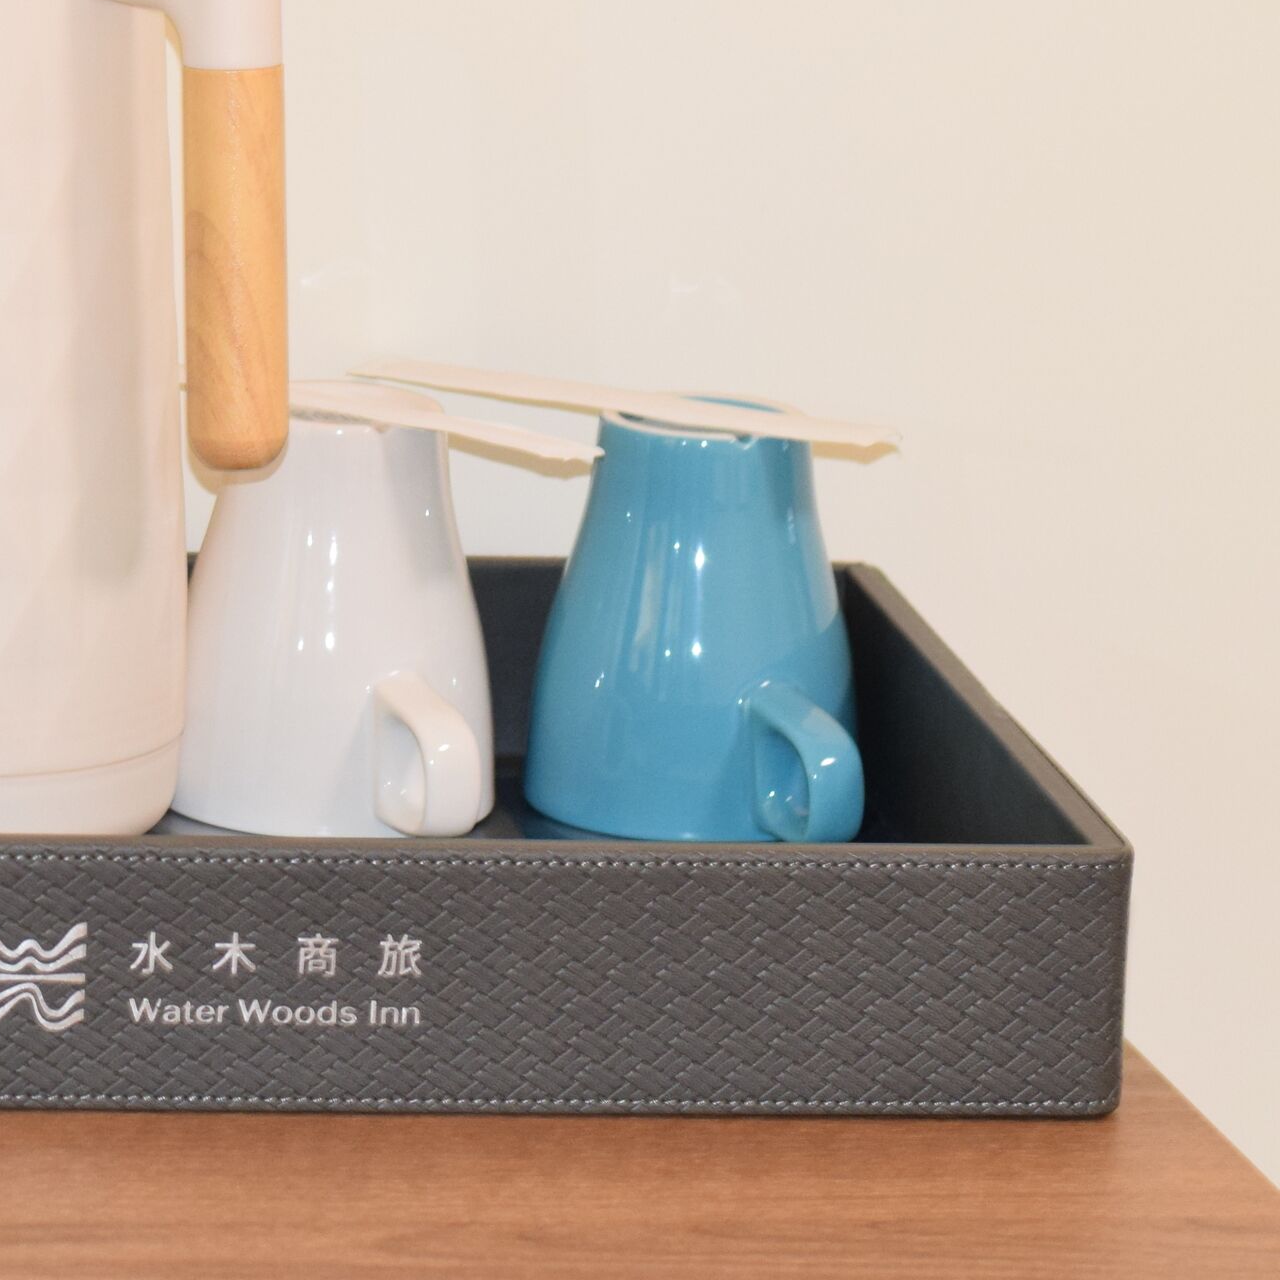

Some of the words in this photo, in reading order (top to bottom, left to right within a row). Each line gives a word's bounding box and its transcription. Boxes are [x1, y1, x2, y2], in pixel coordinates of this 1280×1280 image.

[129, 931, 423, 977] 水木商旅
[128, 996, 230, 1026] Water
[238, 997, 358, 1027] Woods
[369, 999, 421, 1026] Inn
